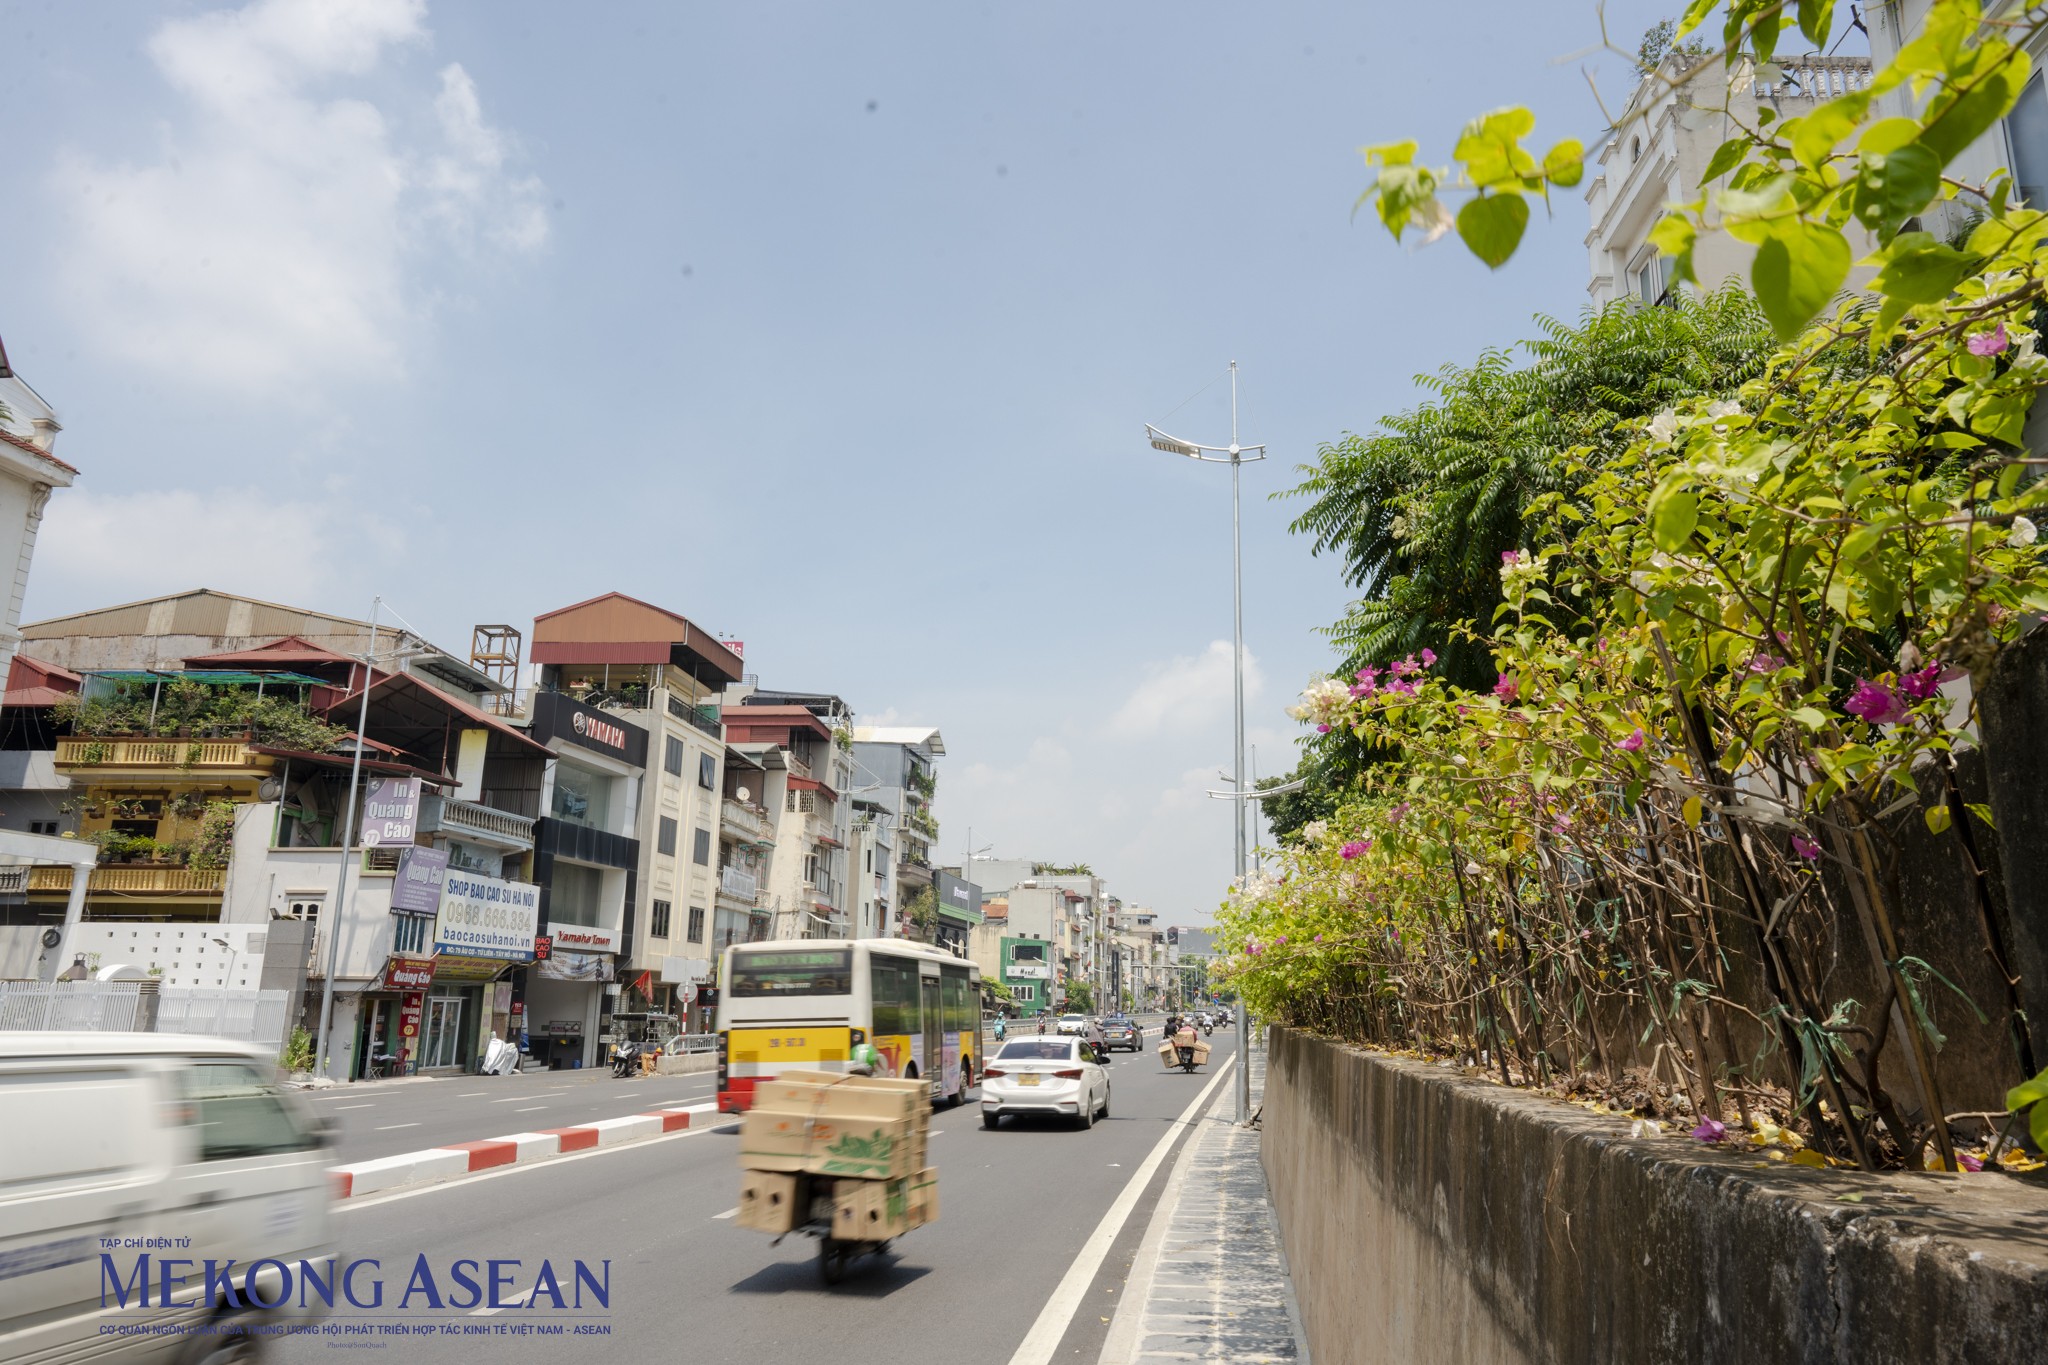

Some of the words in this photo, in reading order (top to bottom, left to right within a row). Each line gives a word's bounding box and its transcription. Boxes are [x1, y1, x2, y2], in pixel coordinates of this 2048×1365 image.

[586, 715, 626, 750] YAMAHA
[393, 781, 408, 798] In
[408, 789, 416, 799] &
[368, 801, 414, 820] Quảng
[383, 821, 411, 838] Cáo
[407, 861, 430, 885] Quảng
[429, 865, 444, 886] Cáo
[447, 878, 470, 897] SHOP
[469, 882, 486, 900] BAO
[486, 886, 501, 903] CAO
[502, 888, 512, 904] SU
[512, 888, 521, 906] HÀ
[522, 890, 535, 910] NỘI
[446, 900, 532, 932] 0968.666.334
[443, 926, 531, 948] baocaosuhanoi.vn
[535, 937, 551, 945] BAO
[557, 930, 592, 944] Yamaha
[591, 934, 611, 946] Town
[535, 944, 550, 952] CAO
[536, 951, 547, 959] SU
[394, 969, 418, 985] Quảng
[418, 971, 431, 984] Cáo
[411, 997, 418, 1006] In
